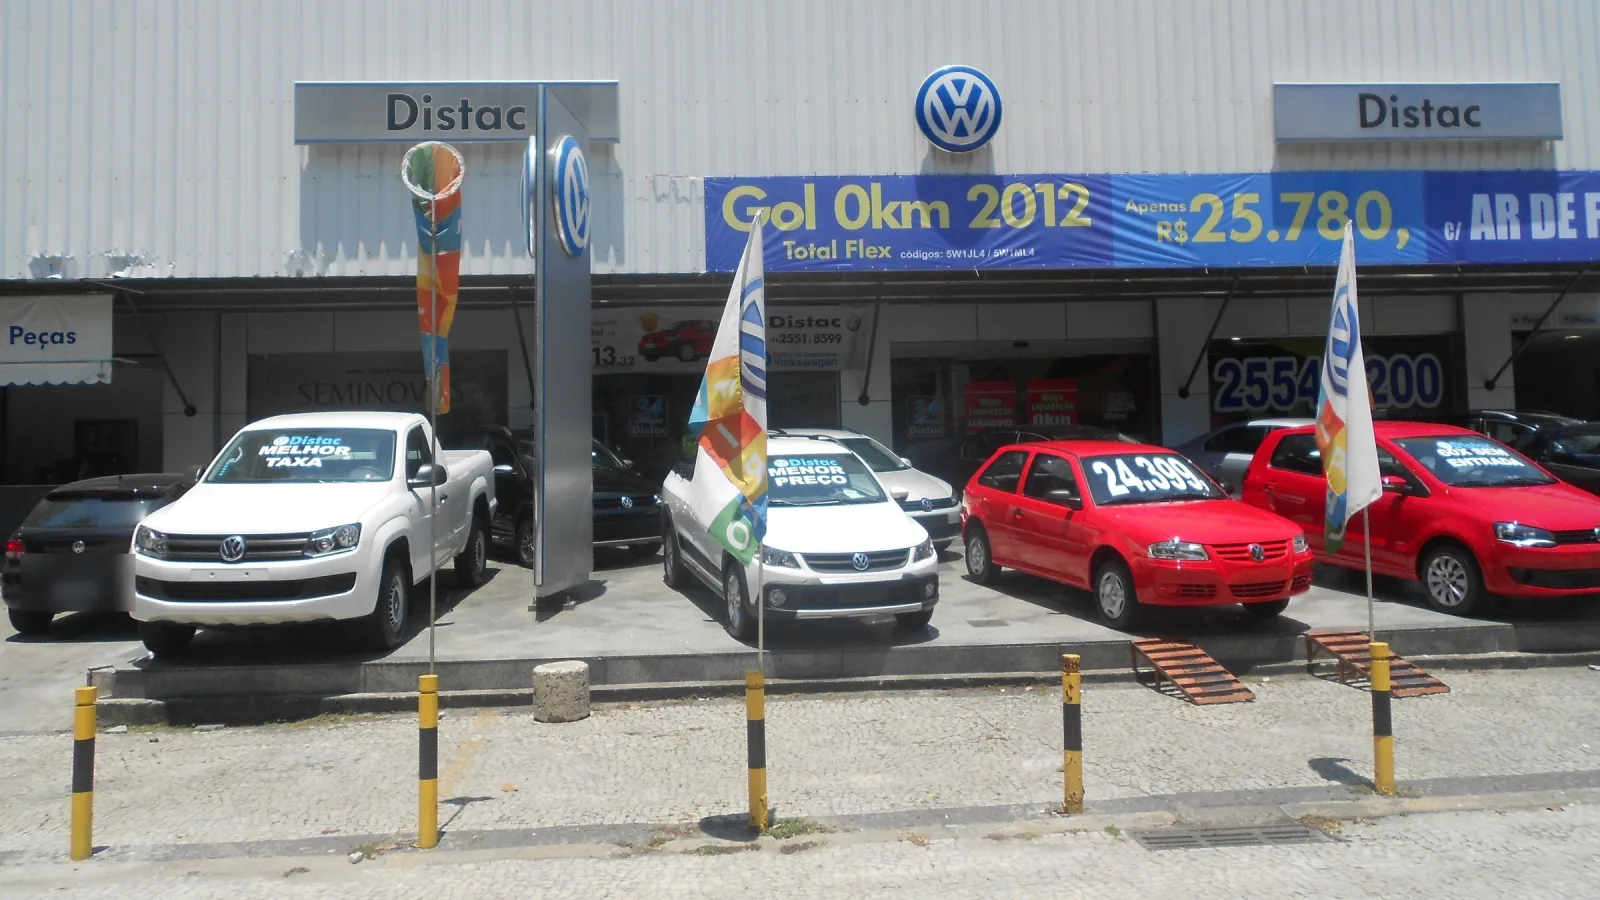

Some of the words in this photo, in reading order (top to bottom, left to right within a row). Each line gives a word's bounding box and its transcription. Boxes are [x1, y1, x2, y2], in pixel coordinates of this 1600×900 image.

[386, 93, 527, 131] Distac
[1357, 92, 1483, 129] Distac
[721, 182, 817, 233] Gol
[965, 182, 1093, 230] 2012
[1124, 198, 1187, 215] Apenas
[1470, 193, 1521, 241] AR
[1529, 192, 1578, 240] DE
[783, 239, 838, 260] Total
[844, 238, 892, 259] Flex
[899, 248, 944, 261] códigos:
[769, 315, 842, 329] Distac
[9, 325, 77, 350] Peças
[773, 357, 838, 369] Volkswagen
[295, 380, 464, 406] SEMINOVS
[288, 435, 342, 446] Distac
[258, 445, 352, 456] MELHOR
[265, 457, 323, 468] TAXA
[788, 458, 838, 467] Distac
[1446, 457, 1526, 468] ENTRADA
[767, 466, 846, 476] MENOR
